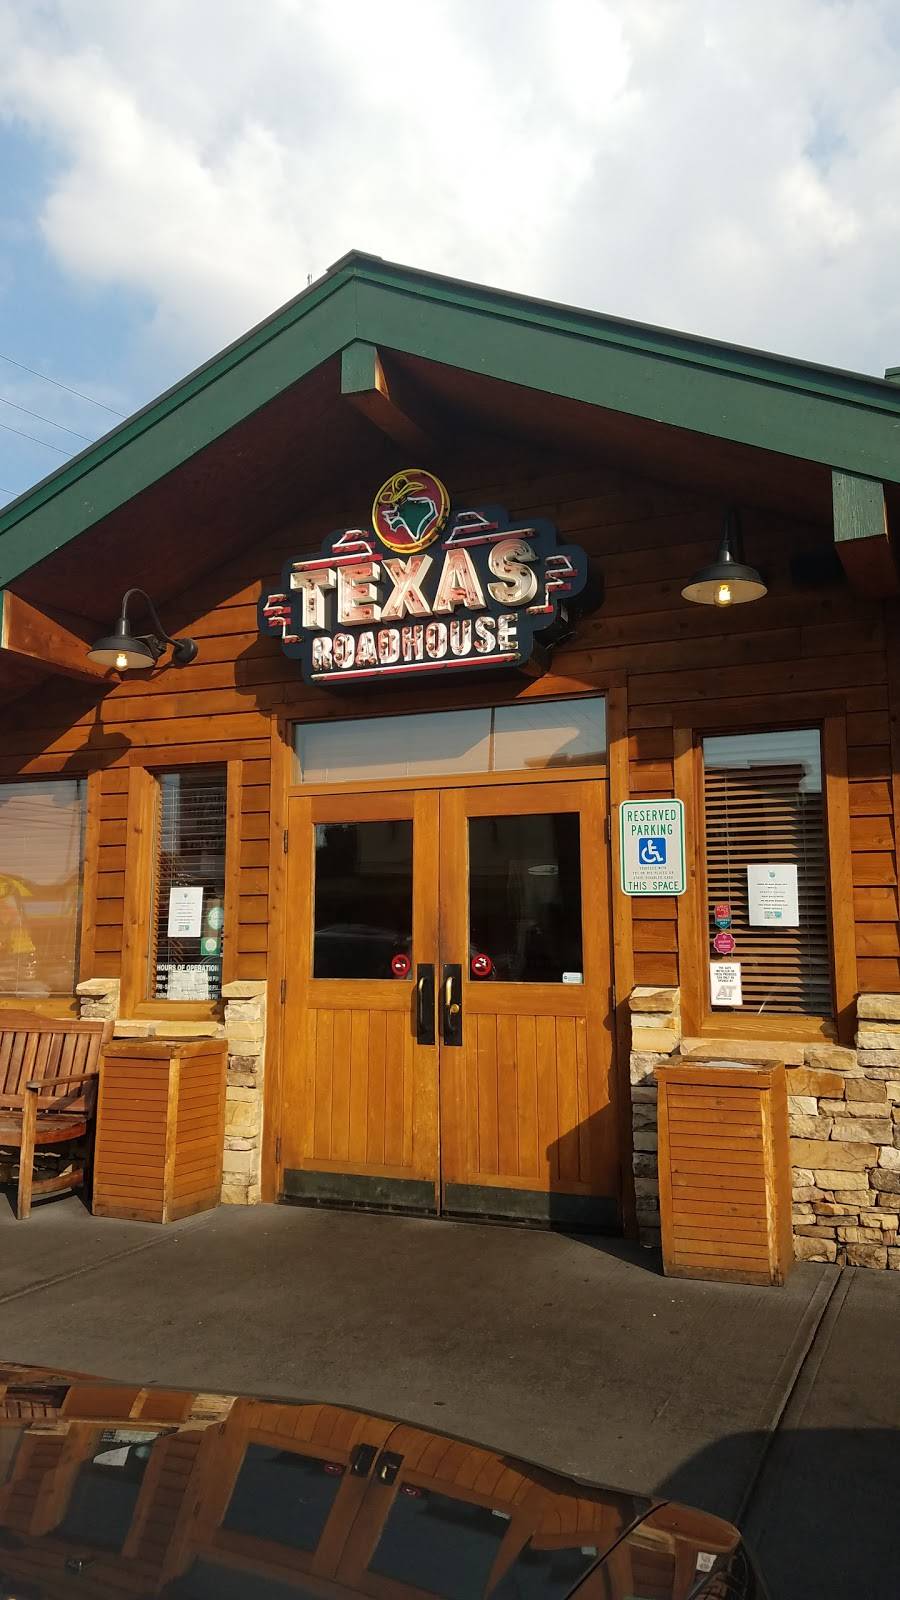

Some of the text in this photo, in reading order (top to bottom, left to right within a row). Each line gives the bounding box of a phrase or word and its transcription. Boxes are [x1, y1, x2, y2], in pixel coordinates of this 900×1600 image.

[290, 539, 539, 630] TEXAS
[311, 613, 519, 671] ROADHOUSE
[627, 809, 677, 822] RESERVED
[631, 824, 673, 836] PARKING
[628, 881, 679, 890] THIS SPACE
[186, 964, 219, 972] OPERATION
